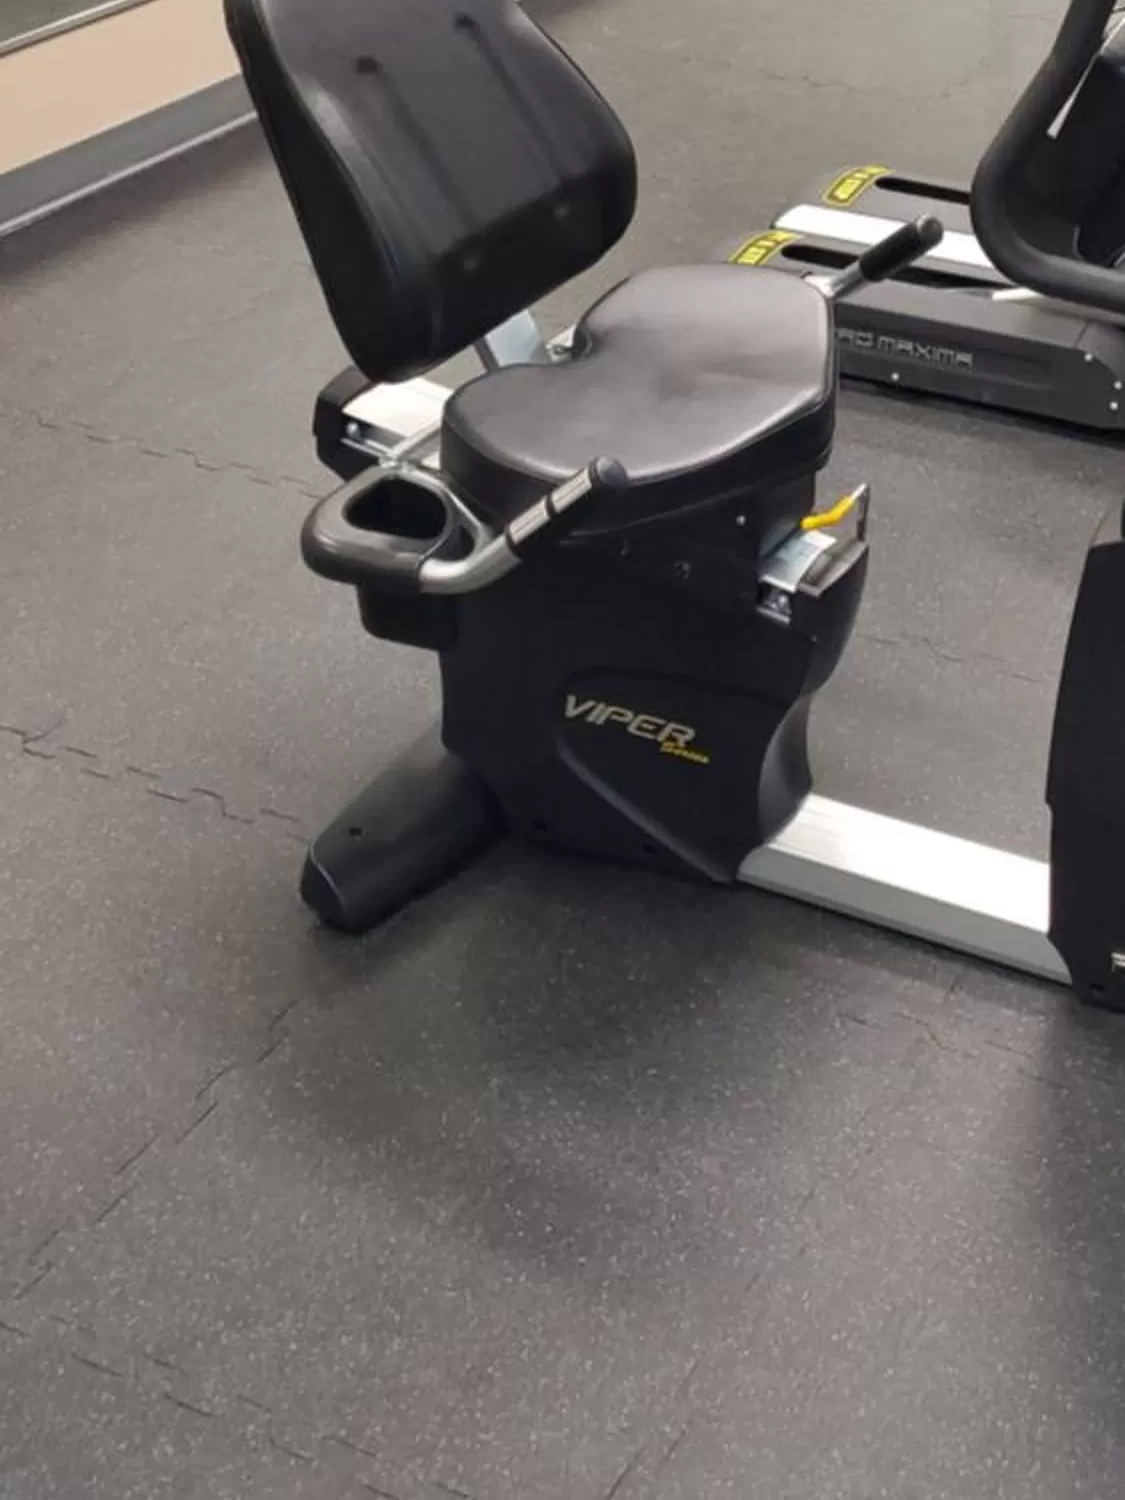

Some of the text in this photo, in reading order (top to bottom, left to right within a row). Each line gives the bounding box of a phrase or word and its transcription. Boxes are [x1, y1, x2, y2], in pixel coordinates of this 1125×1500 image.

[836, 328, 973, 368] RO MAXIMA
[563, 693, 696, 747] VIPER
